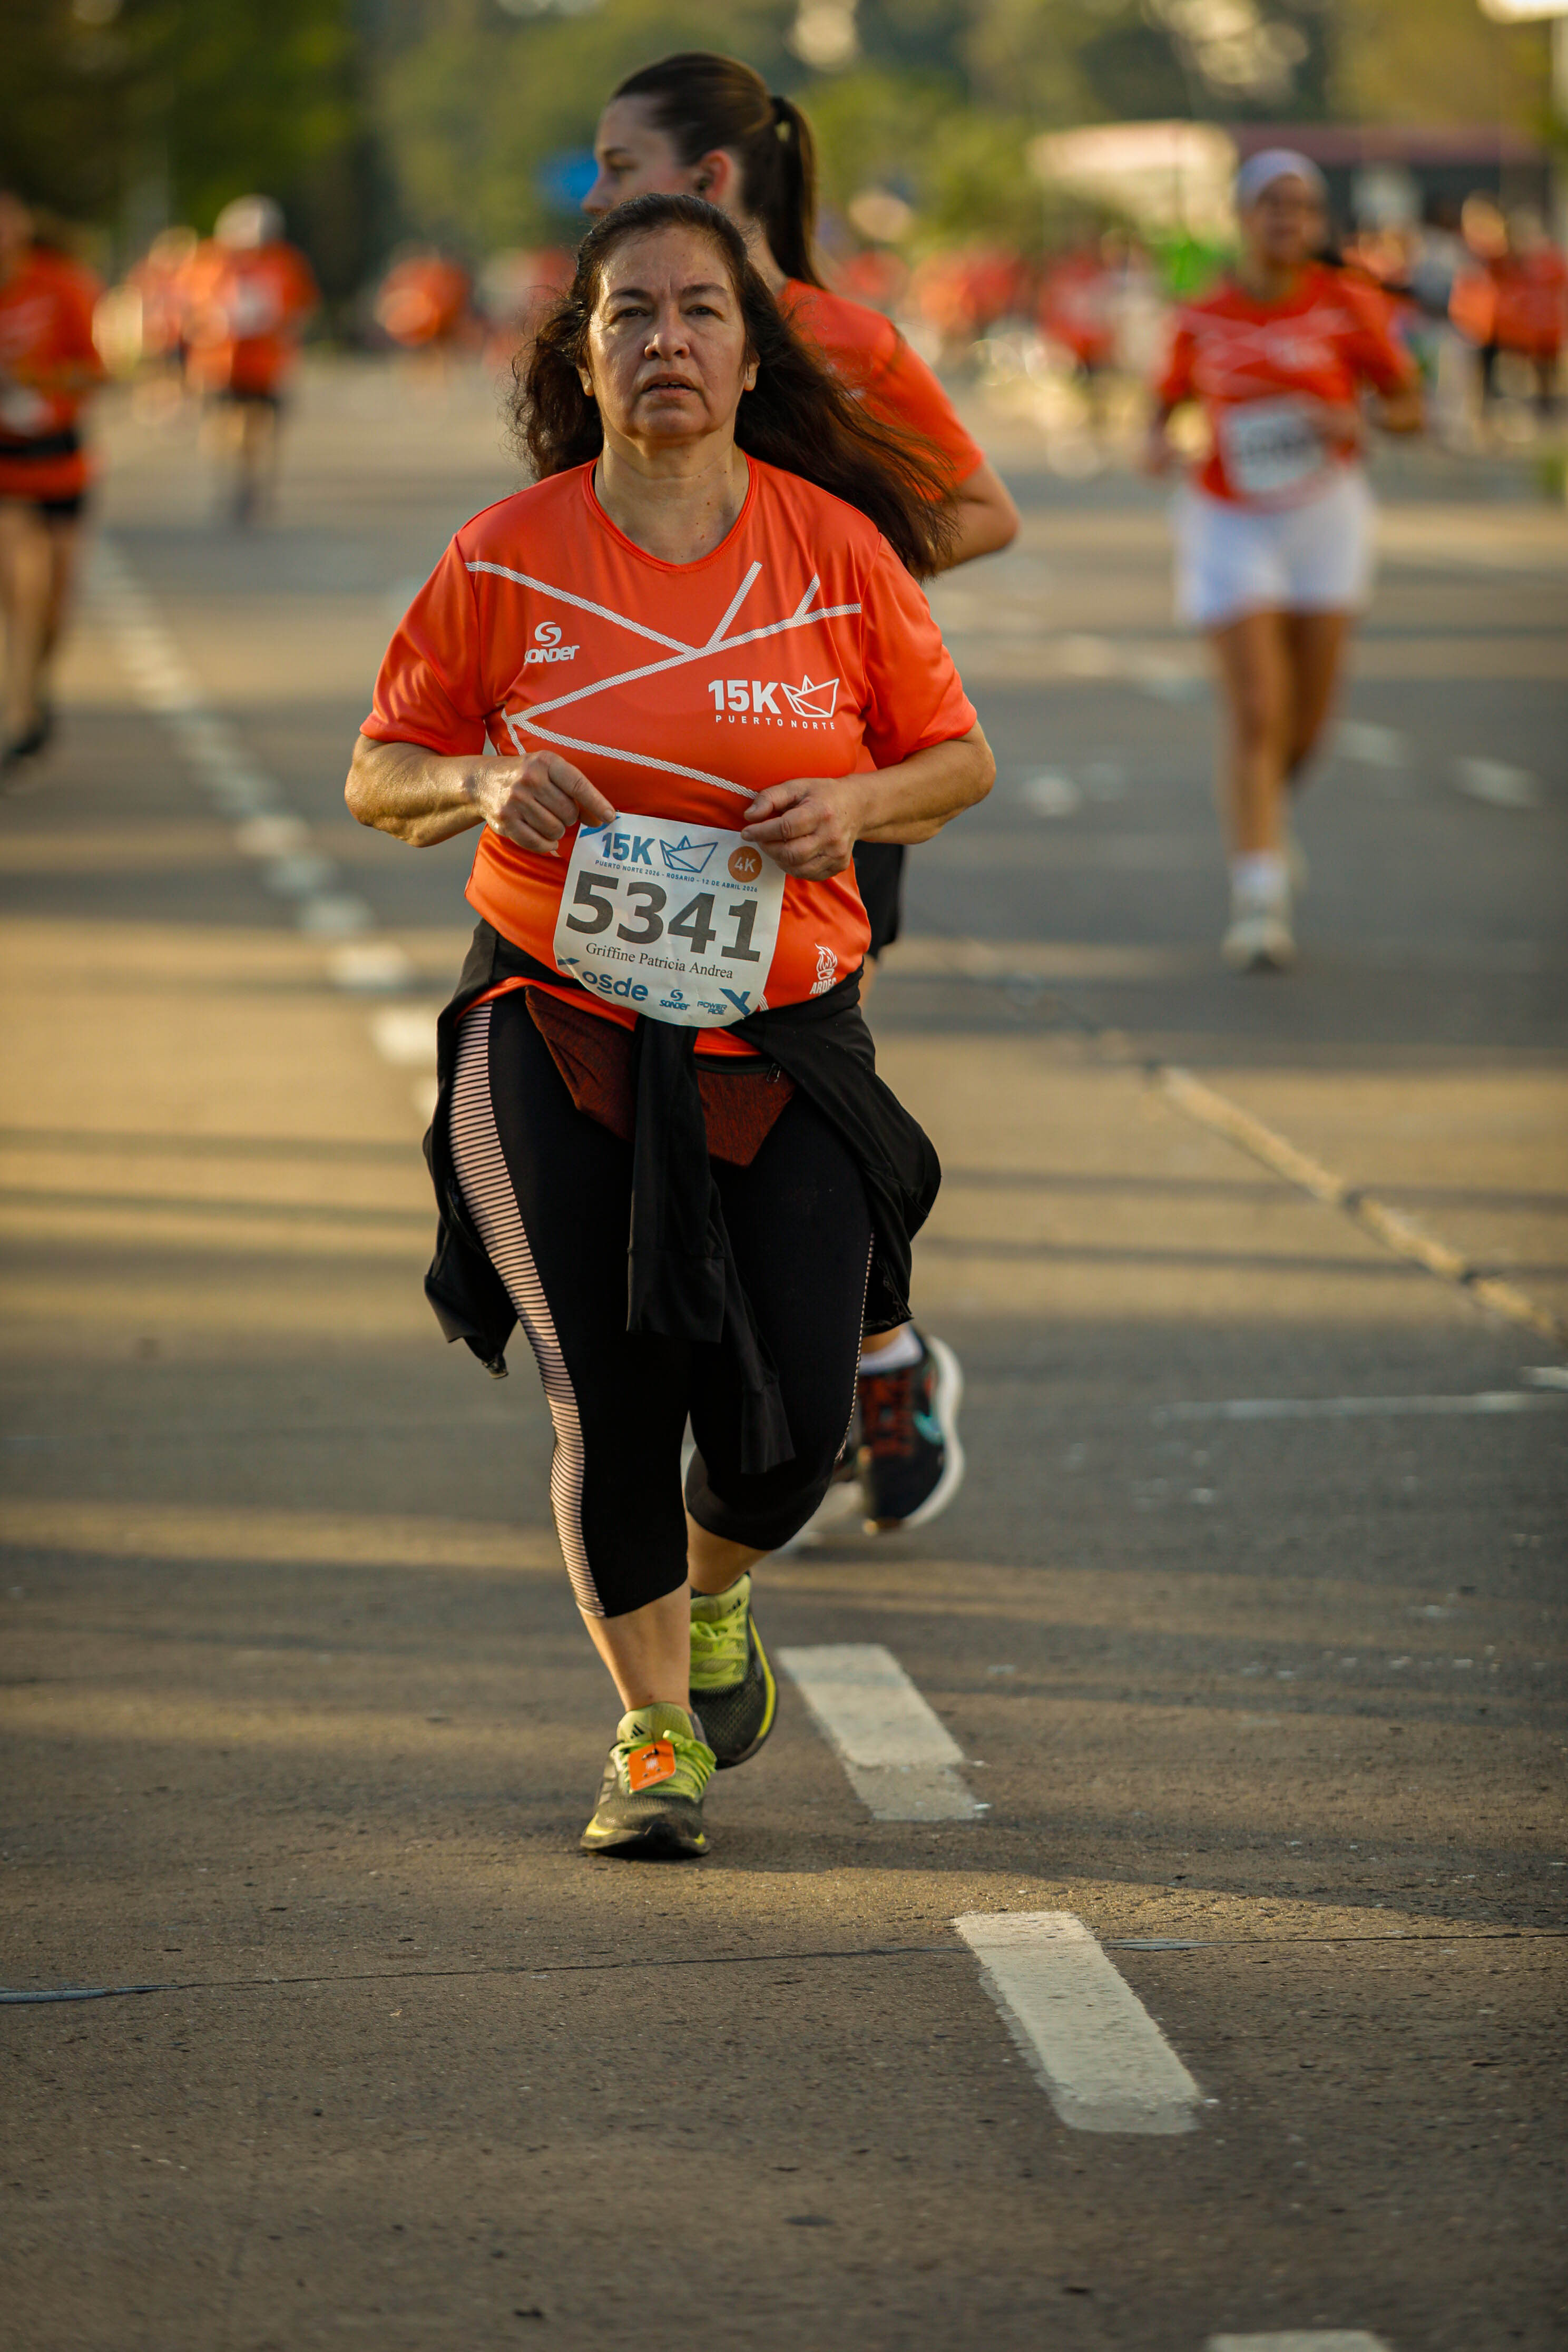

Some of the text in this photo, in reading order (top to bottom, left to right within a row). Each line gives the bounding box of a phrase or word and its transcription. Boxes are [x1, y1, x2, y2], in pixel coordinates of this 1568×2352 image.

[708, 680, 782, 714] 15K
[715, 714, 835, 730] PUERTO NORTE
[602, 832, 655, 865] 15K
[595, 859, 620, 869] PUERTO
[667, 873, 694, 882] ROSARIO
[721, 881, 741, 890] ABRIL
[733, 857, 755, 873] 4K
[566, 870, 761, 963] 5341
[586, 942, 733, 979] Griffine Patricia Andrea
[582, 970, 648, 1001] osde
[697, 1001, 728, 1010] POWER
